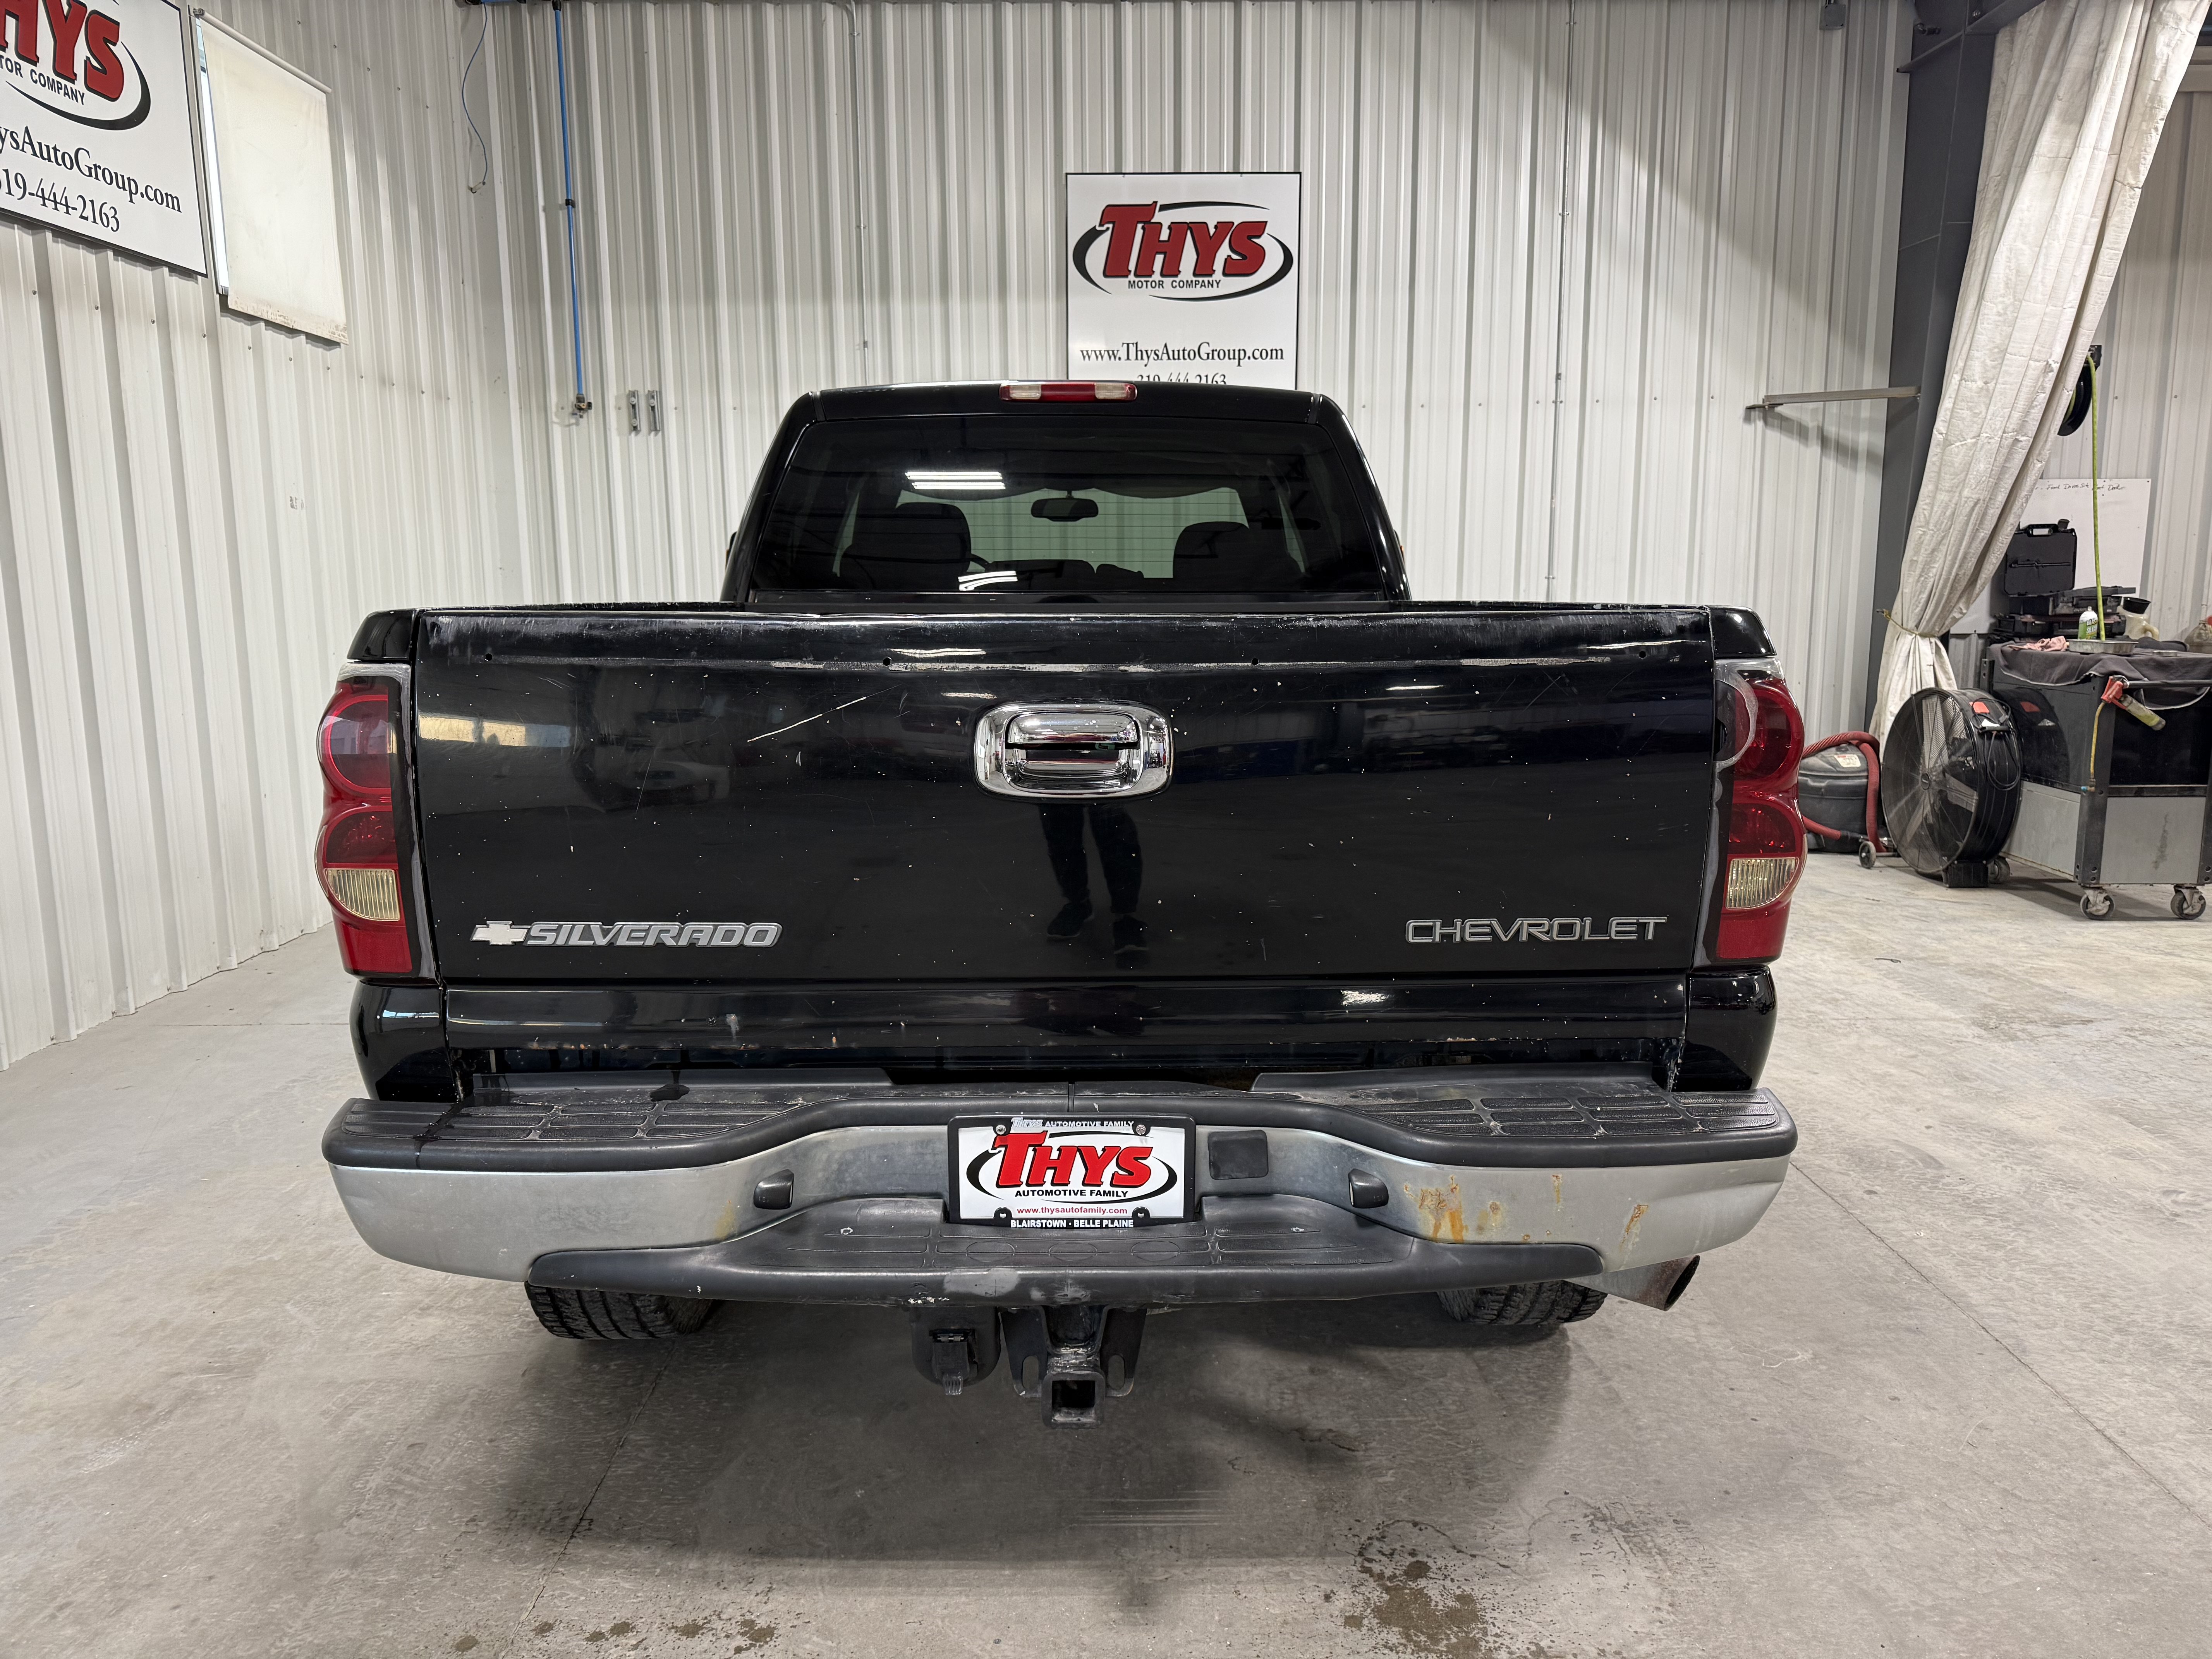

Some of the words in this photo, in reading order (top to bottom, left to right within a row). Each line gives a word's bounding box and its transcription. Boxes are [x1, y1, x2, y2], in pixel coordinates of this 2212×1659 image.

[30, 69, 85, 105] COMPANY
[0, 169, 120, 232] 19-444-2163
[1099, 201, 1268, 278] THYS
[1128, 280, 1164, 289] MOTOR
[1171, 280, 1221, 289] COMPANY
[1080, 342, 1284, 367] www.ThysAutoGroup.com
[525, 923, 781, 946] SILVERADO
[1406, 917, 1667, 943] CHEVROLET
[1011, 1117, 1043, 1128] THYS
[992, 1130, 1154, 1188] THYS
[1017, 1206, 1127, 1214] www.thysautofamily.com
